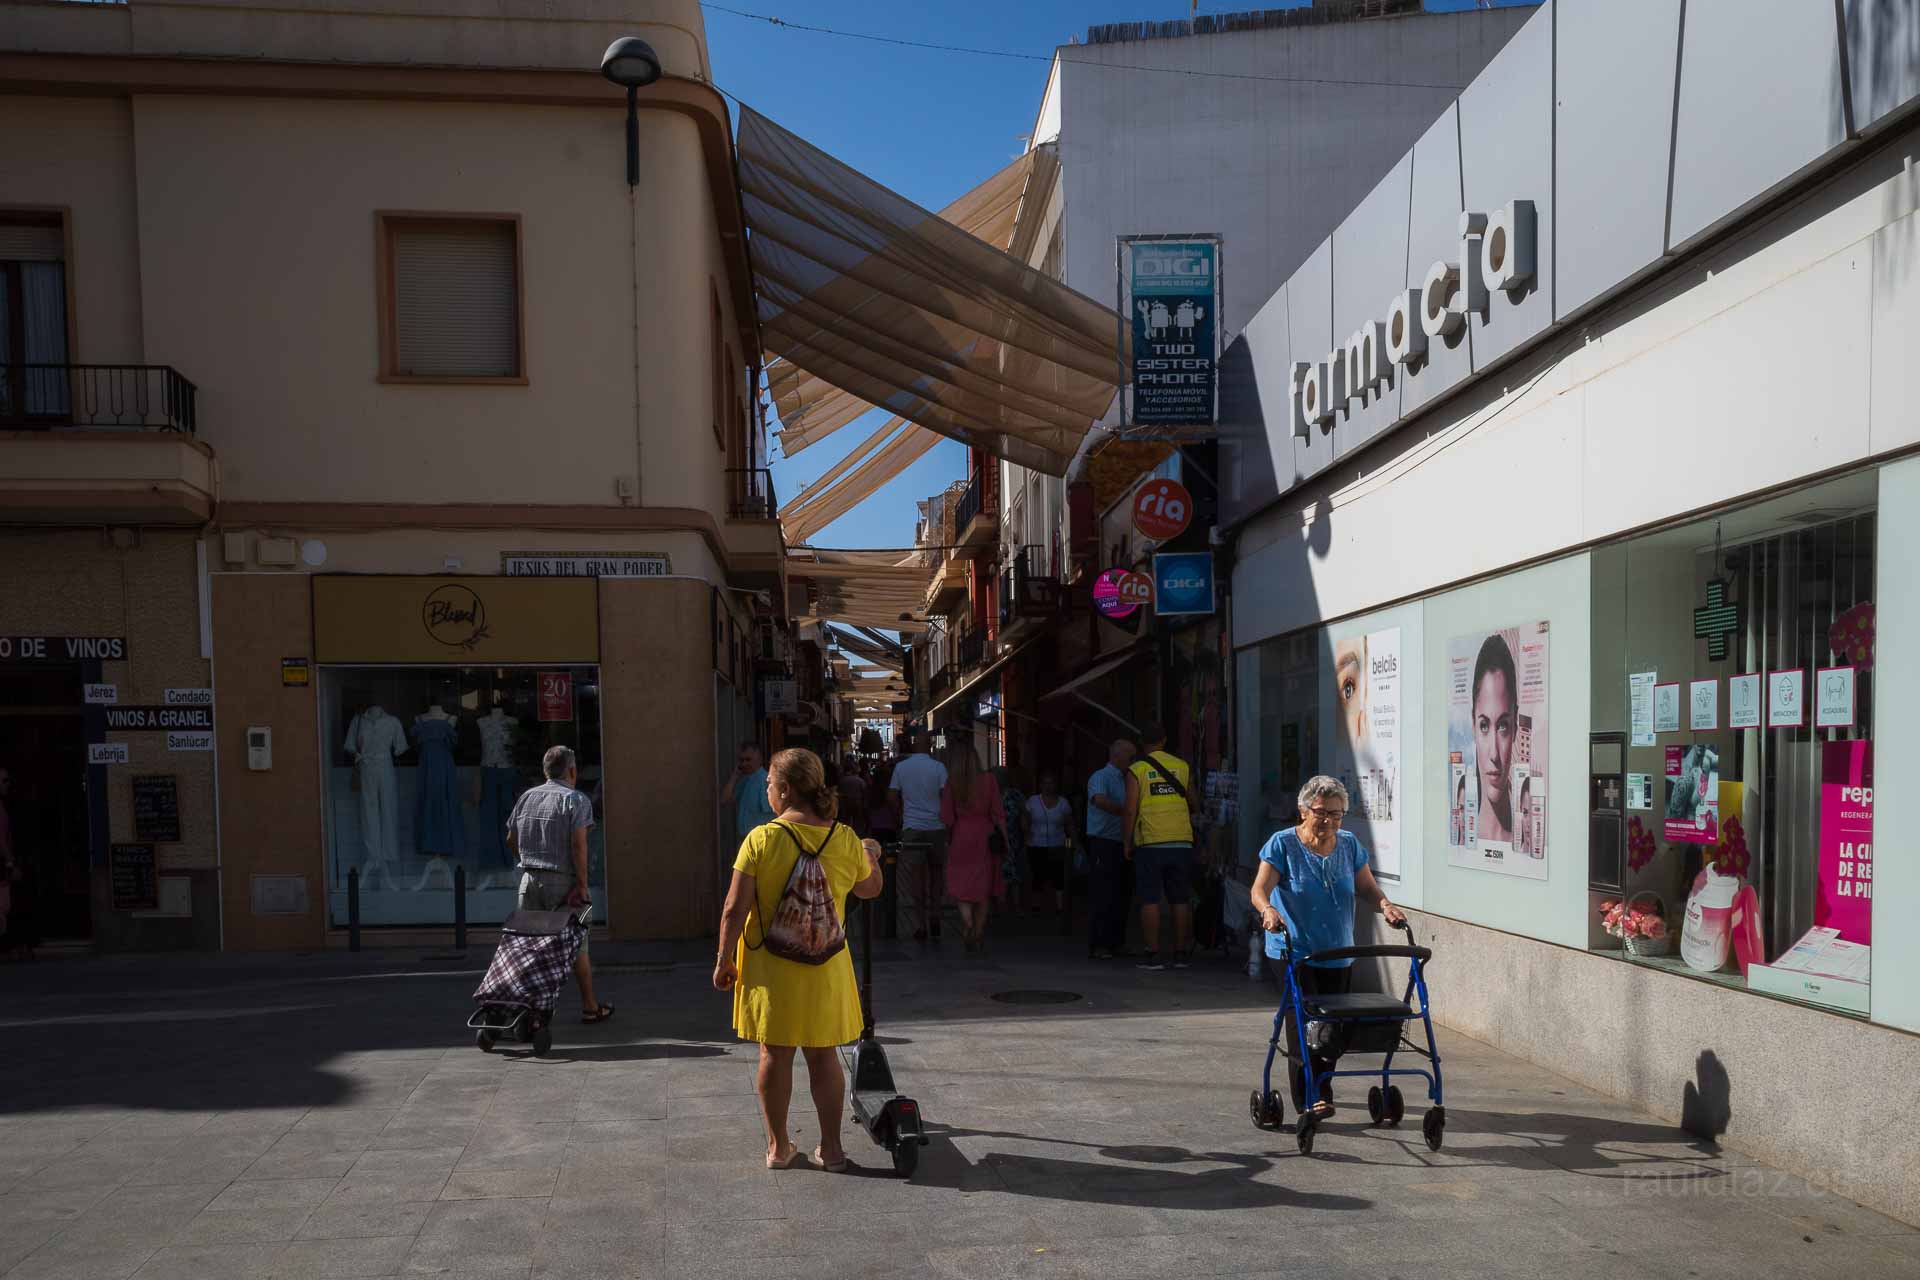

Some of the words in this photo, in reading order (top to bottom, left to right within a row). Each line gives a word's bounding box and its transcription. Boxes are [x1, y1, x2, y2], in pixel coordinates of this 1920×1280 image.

[1136, 258, 1209, 276] DIGI
[1289, 200, 1537, 446] farmacia
[1152, 344, 1195, 355] TWO
[1137, 359, 1210, 370] SISTER
[1138, 373, 1209, 384] PHONE
[1139, 486, 1184, 522] ria
[556, 560, 577, 577] DEL
[586, 561, 617, 576] GRAN
[1122, 577, 1150, 597] ria
[1163, 578, 1205, 589] DIGI
[21, 638, 47, 657] DE
[65, 637, 123, 658] VINOS
[1372, 655, 1398, 675] belcils
[88, 685, 115, 700] Jerez
[167, 689, 211, 704] Condado
[543, 679, 567, 697] 20
[106, 710, 145, 728] VINOS
[147, 710, 158, 727] A
[159, 710, 211, 727] GRANEL
[92, 746, 126, 763] Lebrija
[1840, 842, 1854, 859] LA
[1839, 860, 1854, 878] DE
[1837, 880, 1852, 897] LA
